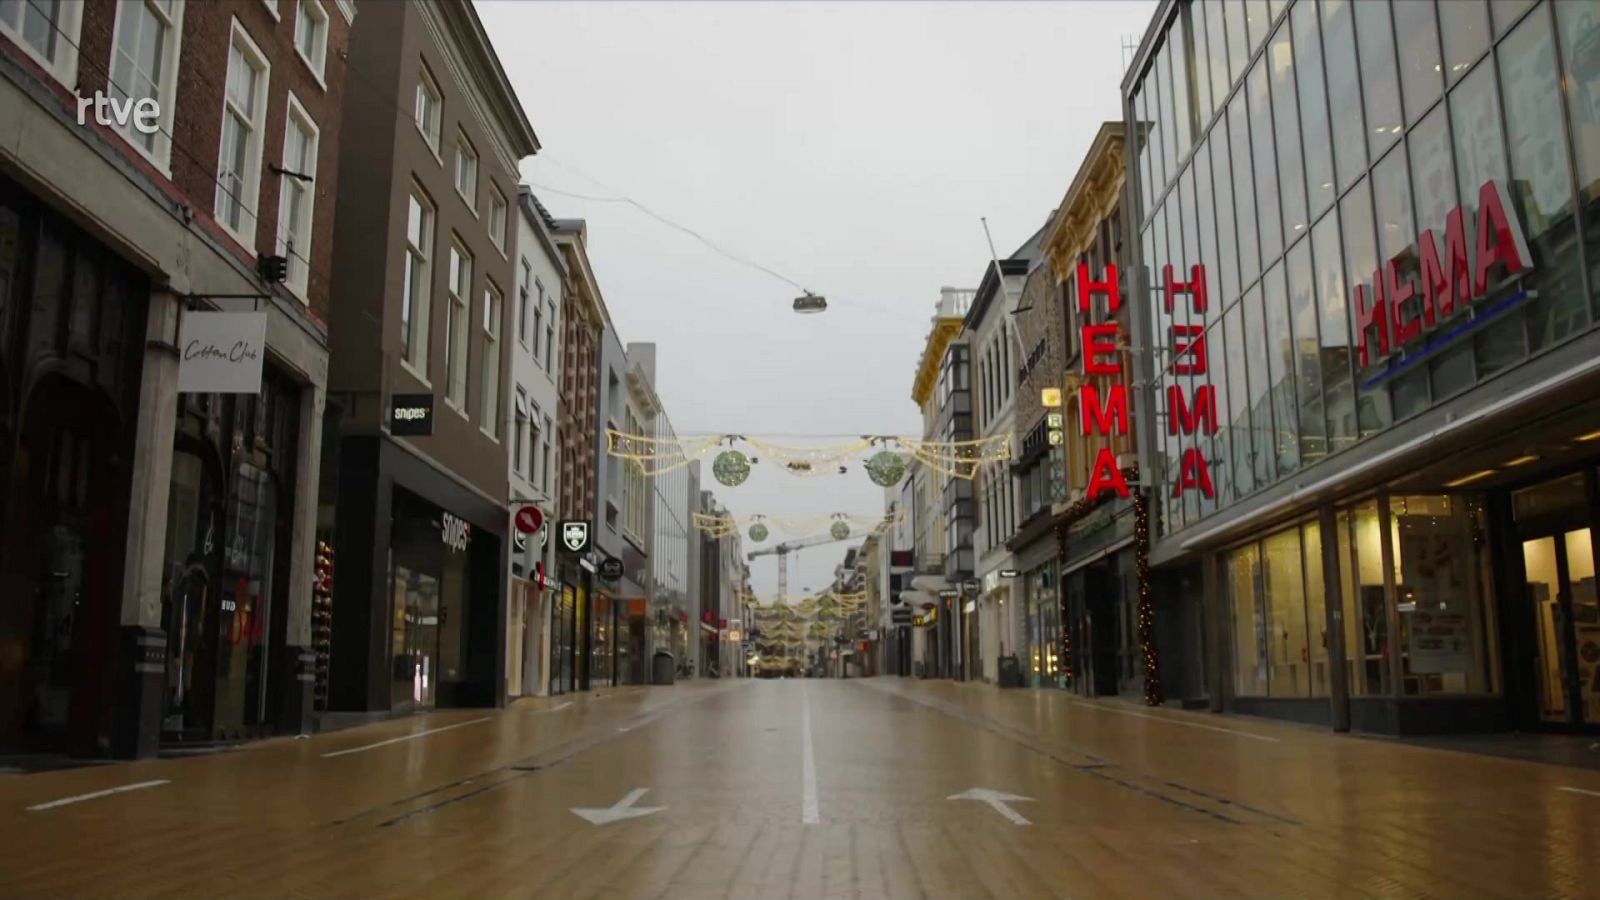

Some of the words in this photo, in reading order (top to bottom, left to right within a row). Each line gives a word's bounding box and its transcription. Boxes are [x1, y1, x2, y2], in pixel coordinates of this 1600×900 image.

[1353, 179, 1534, 369] HEMA
[184, 339, 227, 361] Cotton
[229, 340, 257, 363] Club
[1075, 262, 1130, 500] HEMA
[394, 407, 426, 421] snipes
[442, 511, 468, 553] snipes
